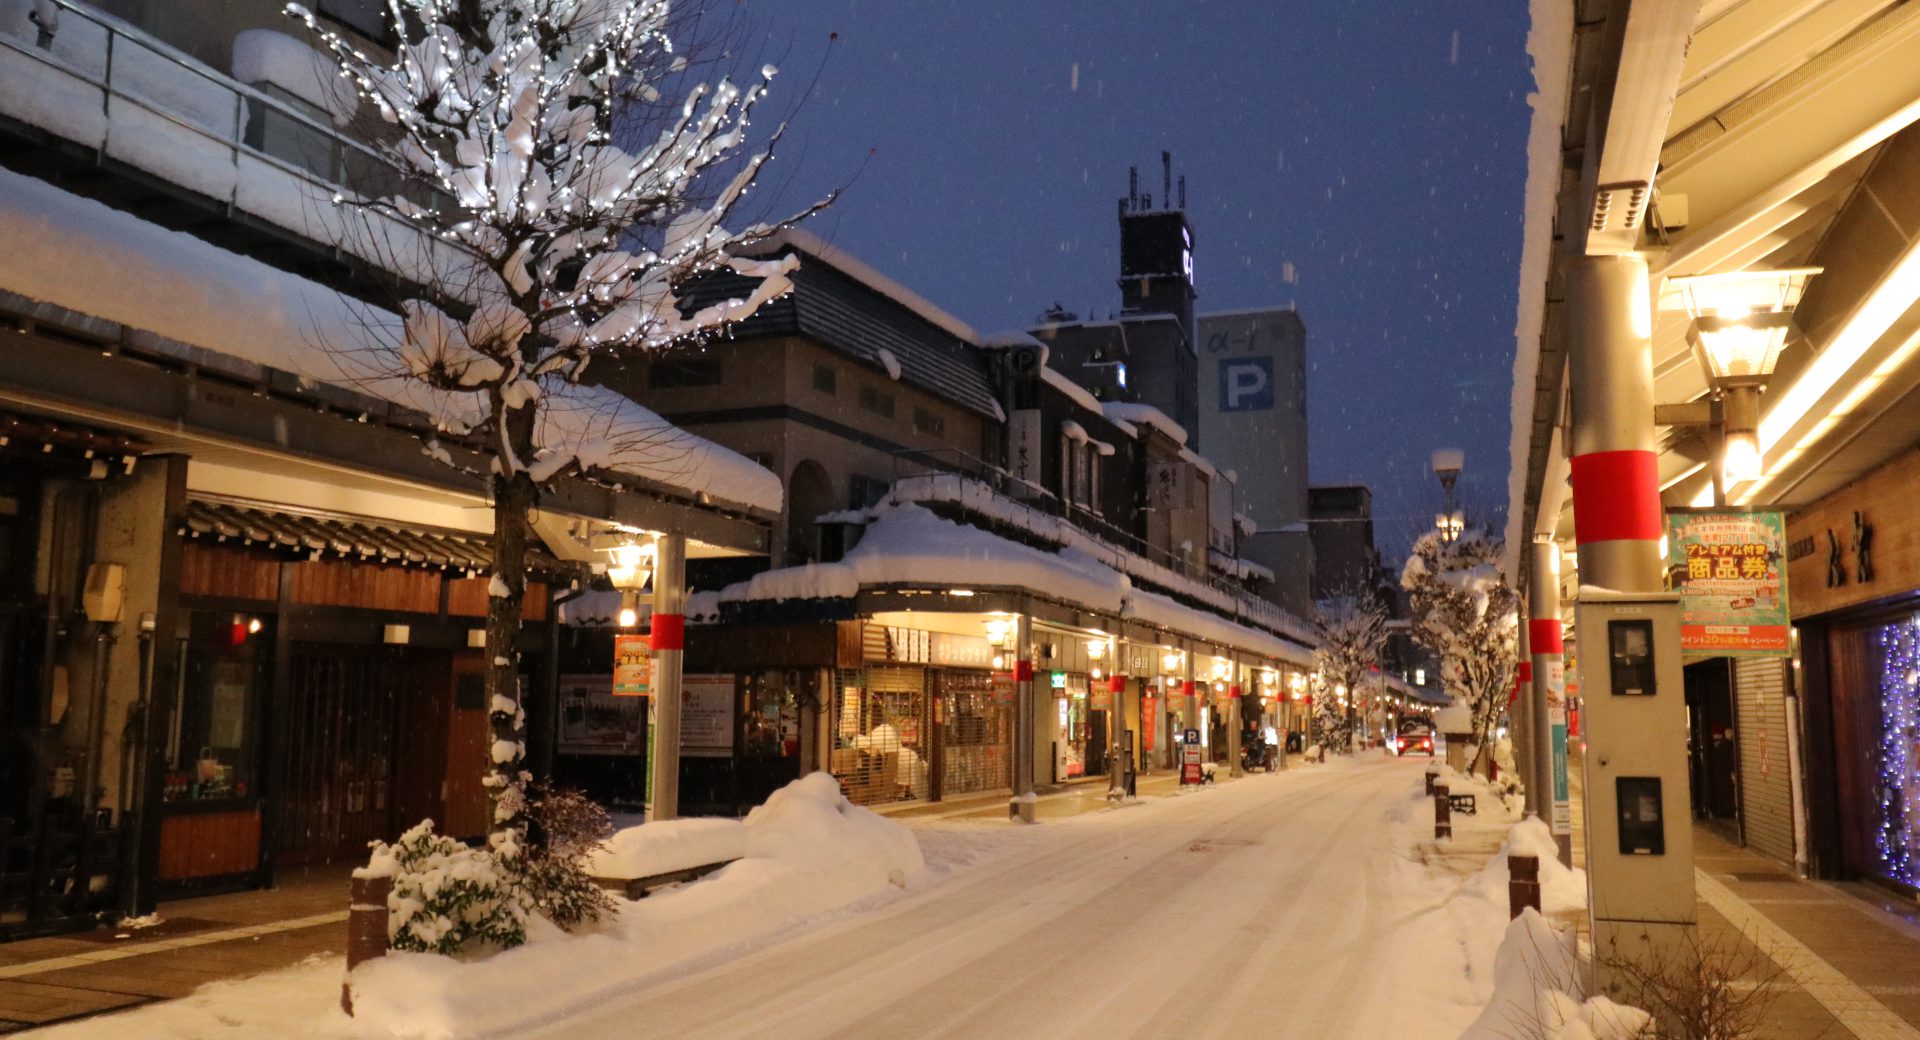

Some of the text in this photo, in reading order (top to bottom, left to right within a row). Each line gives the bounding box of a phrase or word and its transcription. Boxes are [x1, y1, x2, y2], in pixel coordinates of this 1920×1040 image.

[1228, 365, 1267, 408] P
[1686, 544, 1766, 555] プレミアム付き
[1687, 557, 1766, 579] 商品券
[1188, 731, 1197, 742] P
